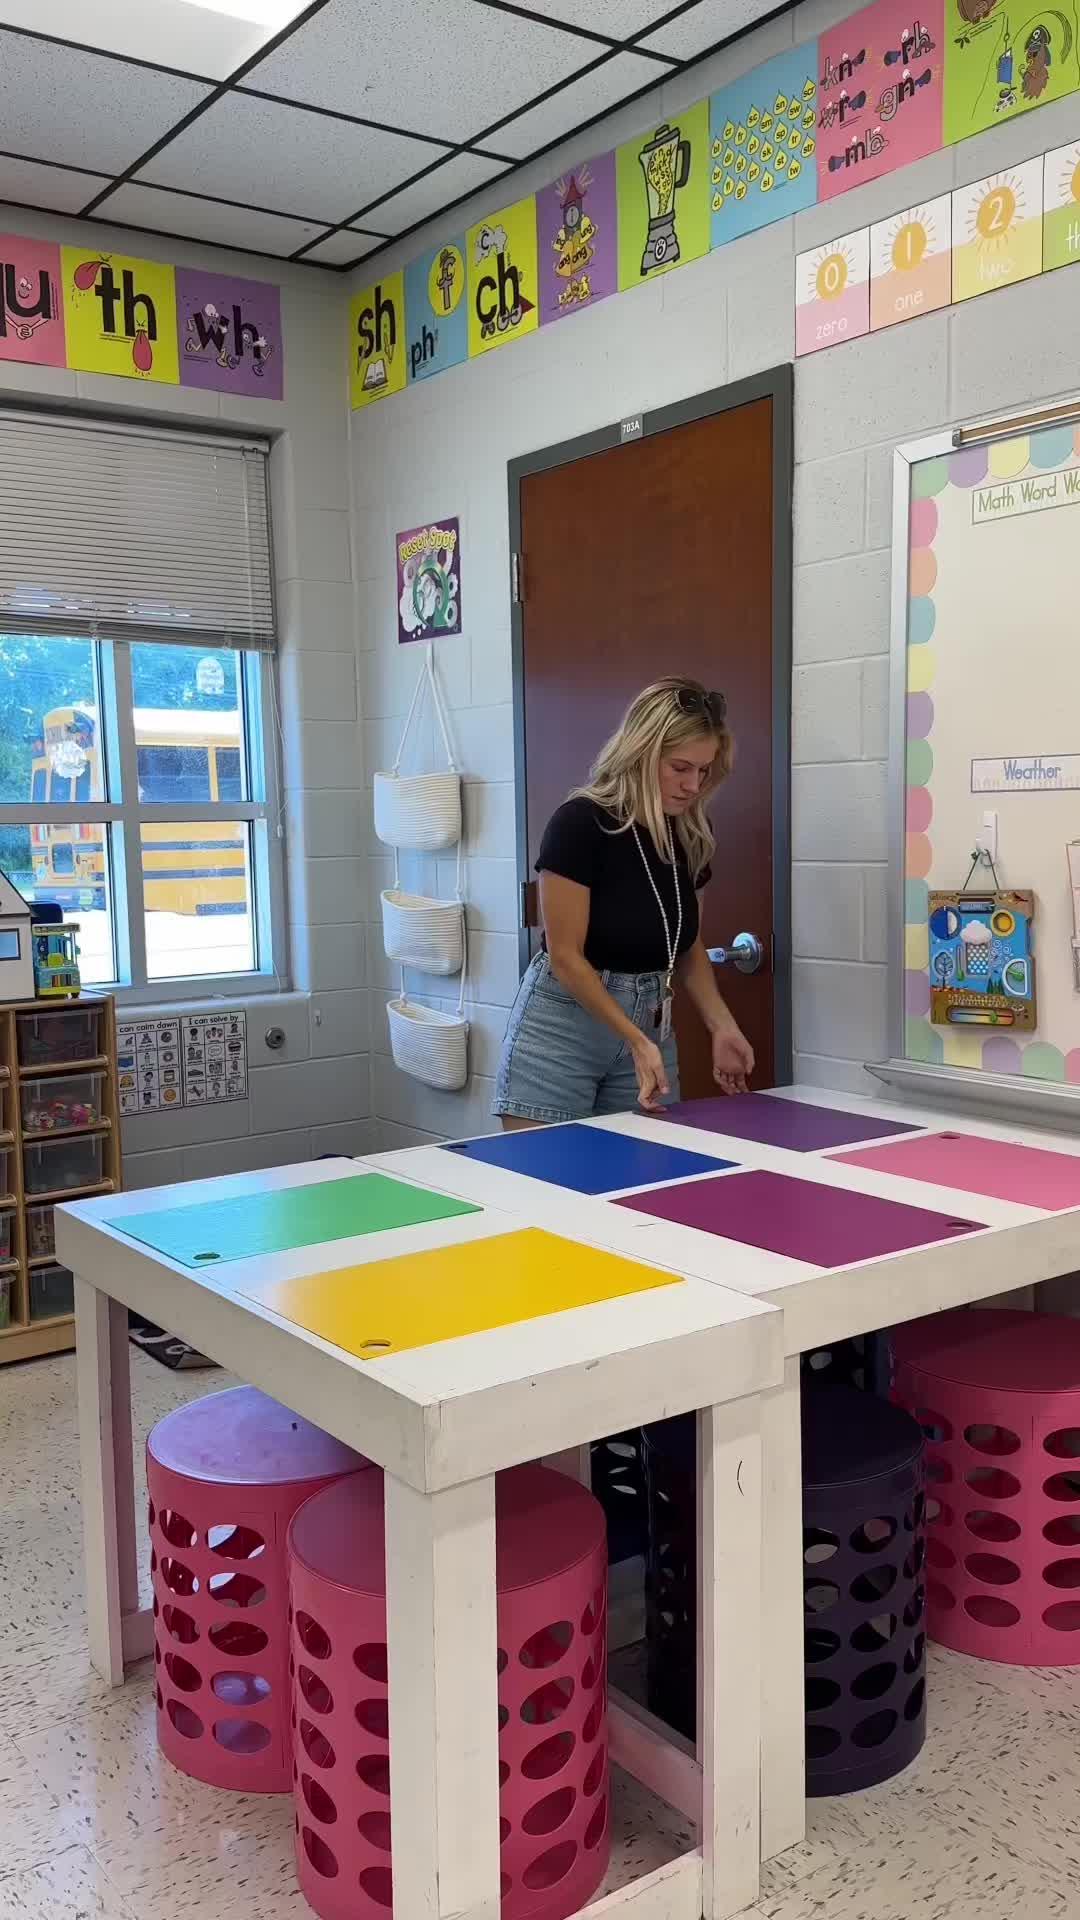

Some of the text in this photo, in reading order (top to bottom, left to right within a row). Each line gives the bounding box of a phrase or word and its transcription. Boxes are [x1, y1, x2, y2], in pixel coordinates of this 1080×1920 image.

[775, 100, 785, 110] sn
[988, 196, 1005, 231] 2
[475, 252, 520, 325] ch
[824, 262, 839, 291] 0
[95, 267, 158, 341] th
[894, 289, 924, 311] one
[193, 305, 262, 359] wh
[356, 286, 397, 359] sh
[815, 316, 848, 341] zero
[410, 324, 435, 378] ph
[622, 420, 641, 434] 703A
[978, 486, 1014, 513] Math
[1021, 475, 1057, 504] Word
[399, 528, 457, 561] Reset Spot
[1003, 758, 1061, 781] Weather
[136, 1023, 155, 1031] calm
[156, 1020, 178, 1029] down
[194, 1018, 209, 1026] can
[210, 1015, 228, 1024] solve
[229, 1014, 239, 1023] by
